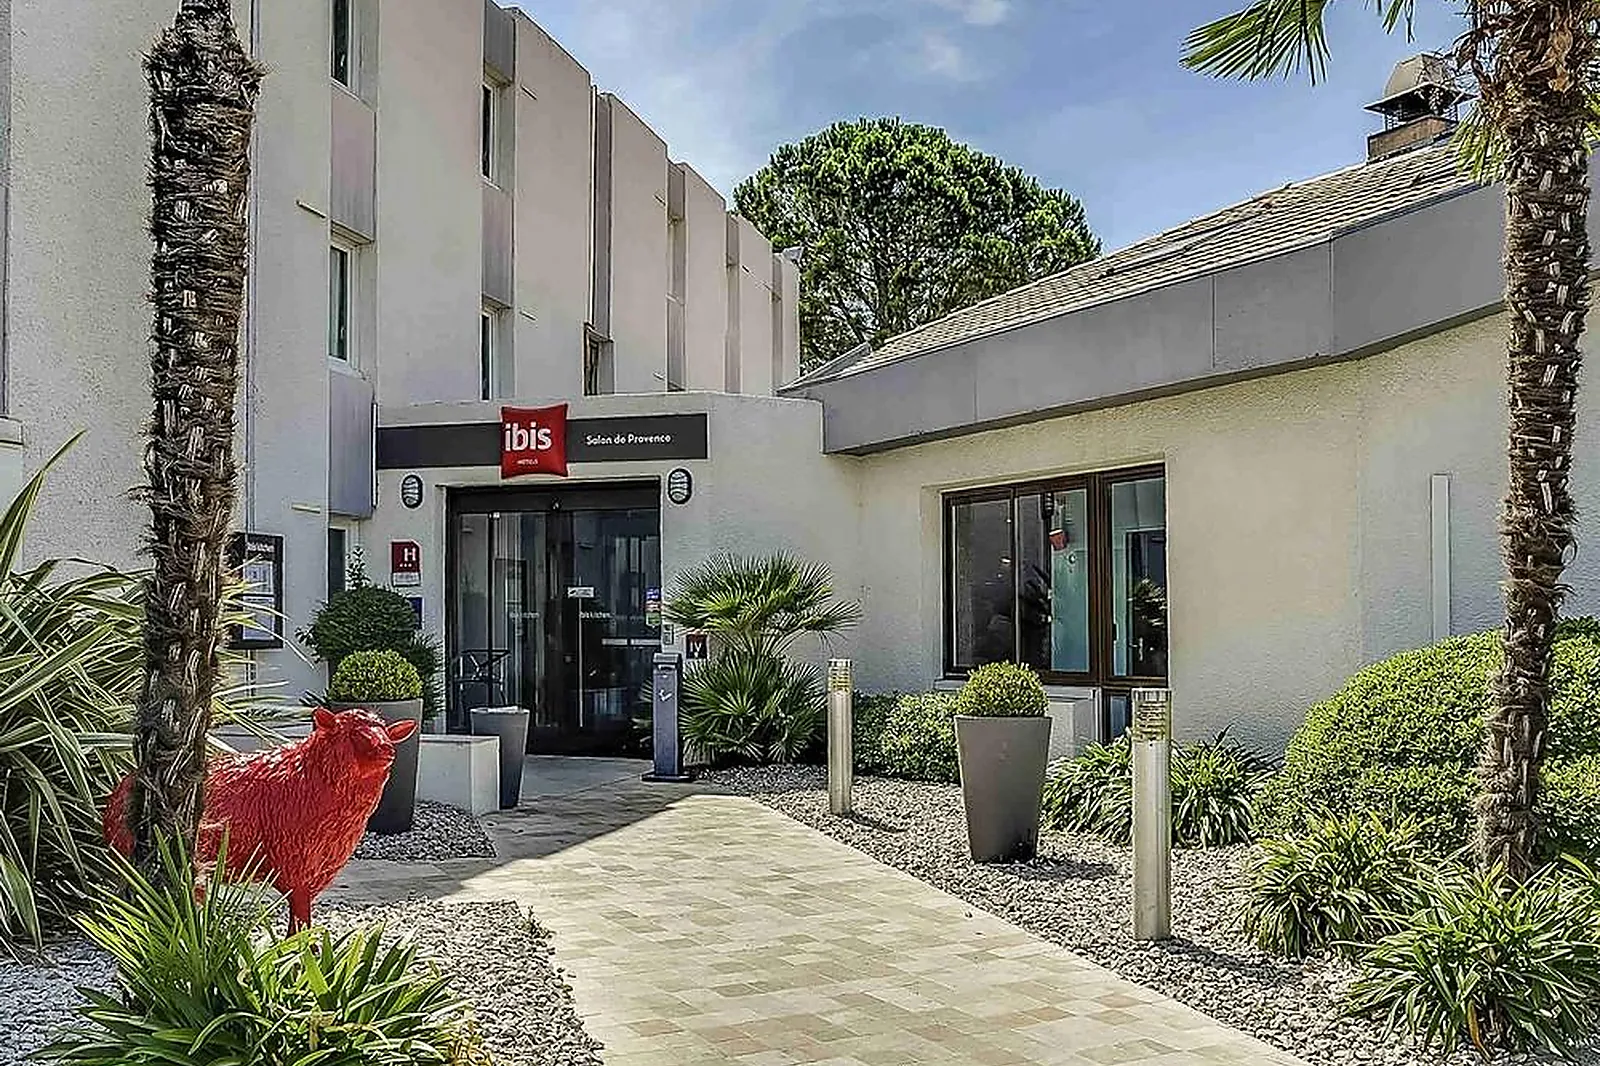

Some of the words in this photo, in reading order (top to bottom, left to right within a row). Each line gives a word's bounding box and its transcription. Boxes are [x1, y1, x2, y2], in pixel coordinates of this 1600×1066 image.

[504, 421, 552, 451] ibis
[586, 434, 612, 446] Salon
[614, 433, 626, 444] de
[627, 433, 671, 444] Provence
[404, 547, 417, 561] H
